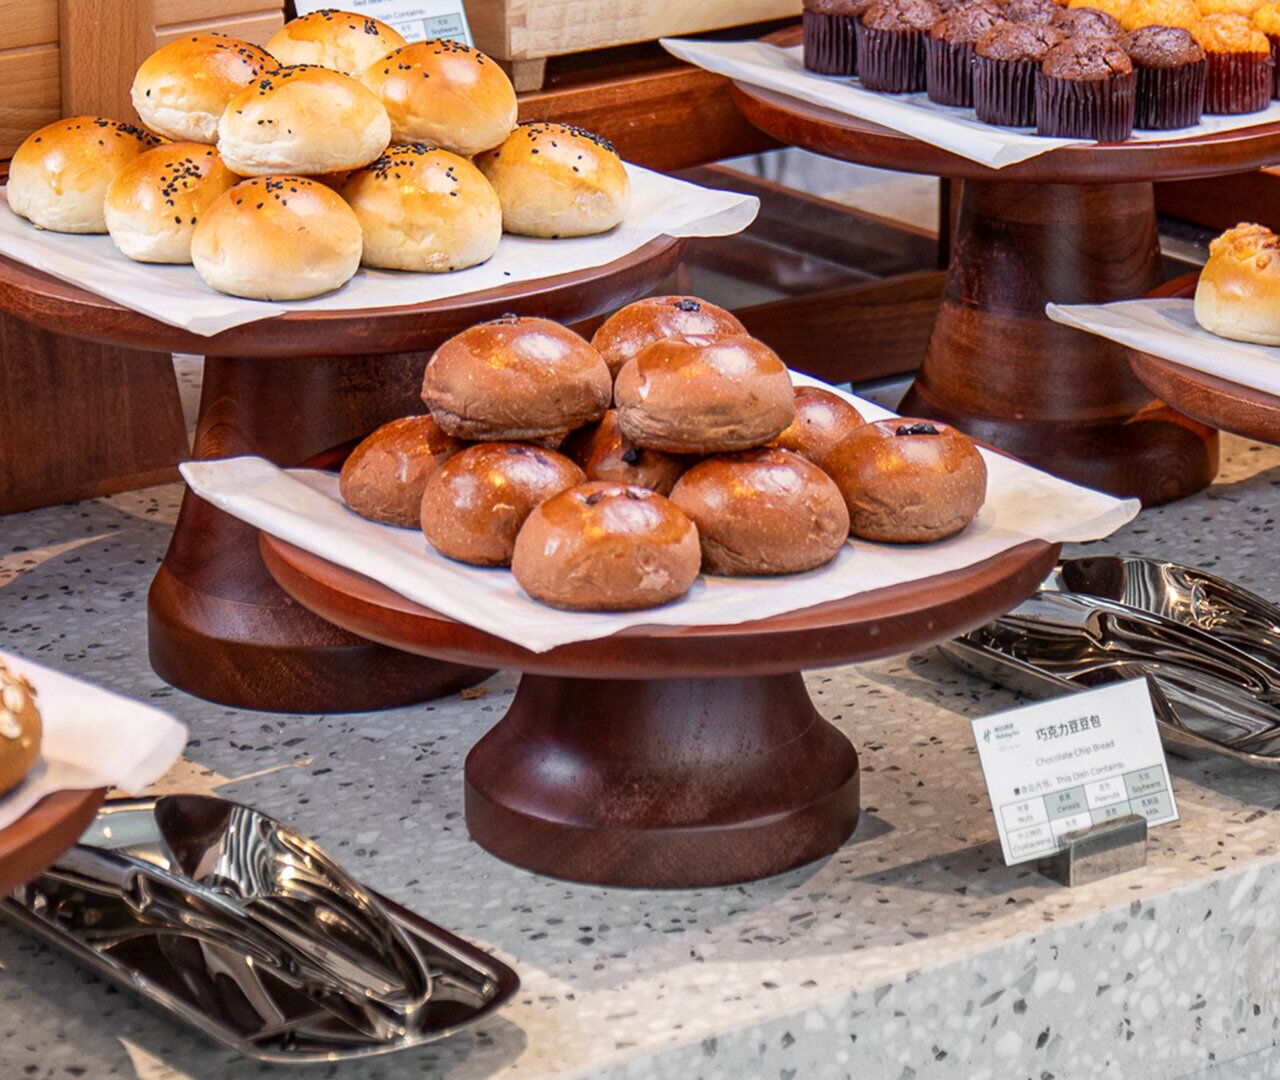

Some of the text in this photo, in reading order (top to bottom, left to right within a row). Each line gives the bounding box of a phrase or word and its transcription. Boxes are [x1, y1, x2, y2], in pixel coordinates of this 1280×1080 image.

[1035, 714, 1102, 741] 巧克力豆豆包
[1035, 739, 1115, 767] Chocolate Chip Bread
[1055, 775, 1072, 784] This
[1072, 770, 1089, 781] Dish
